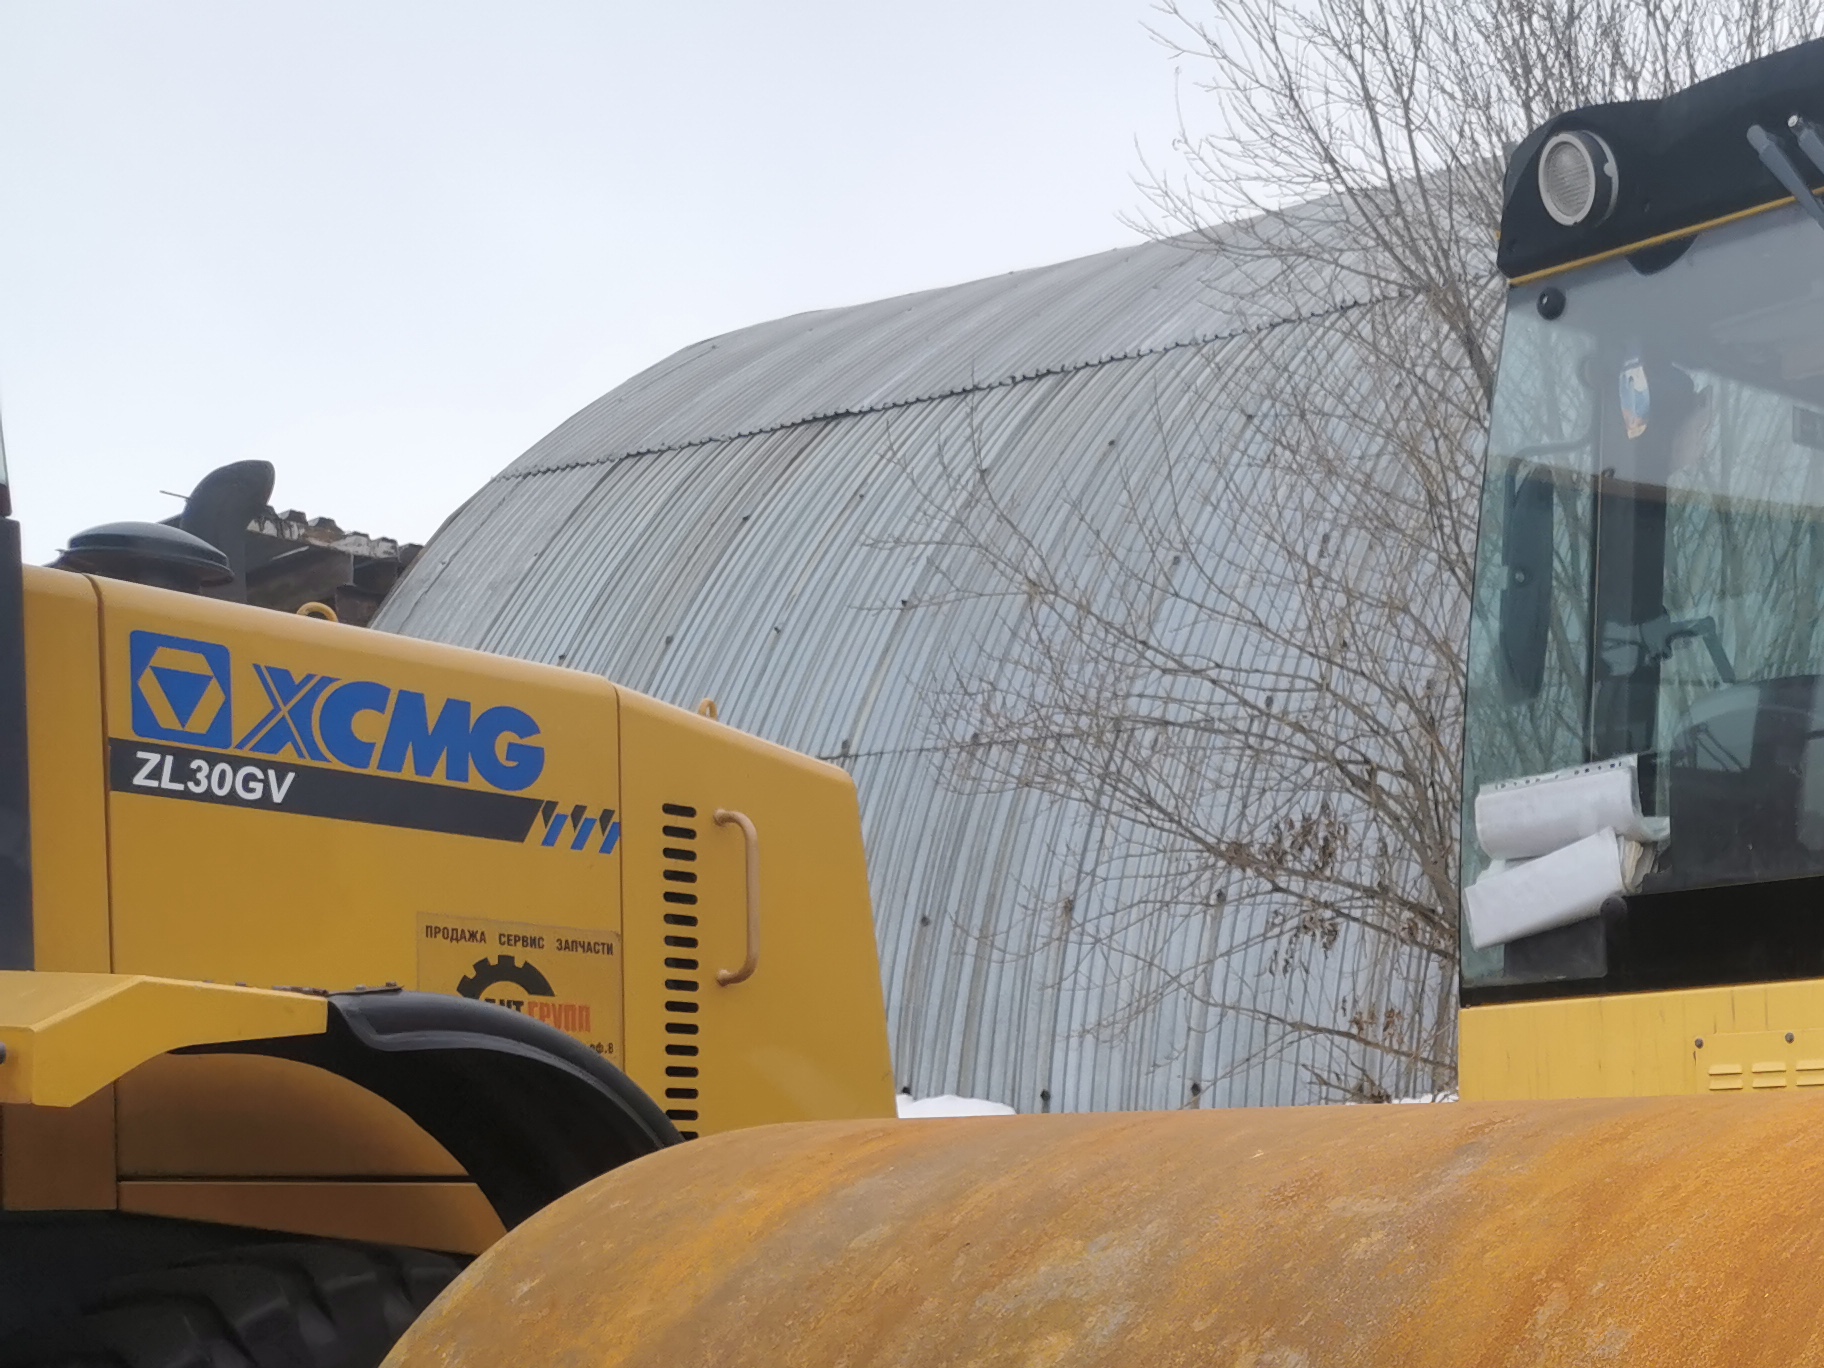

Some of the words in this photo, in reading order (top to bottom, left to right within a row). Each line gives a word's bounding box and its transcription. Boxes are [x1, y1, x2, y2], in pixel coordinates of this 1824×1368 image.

[234, 662, 546, 792] XCMG
[132, 750, 296, 804] ZL30GV
[425, 925, 487, 944] ПРОДАЖА
[498, 933, 545, 950] СЕРВИС
[556, 938, 614, 956] ЗАПЧАСТИ
